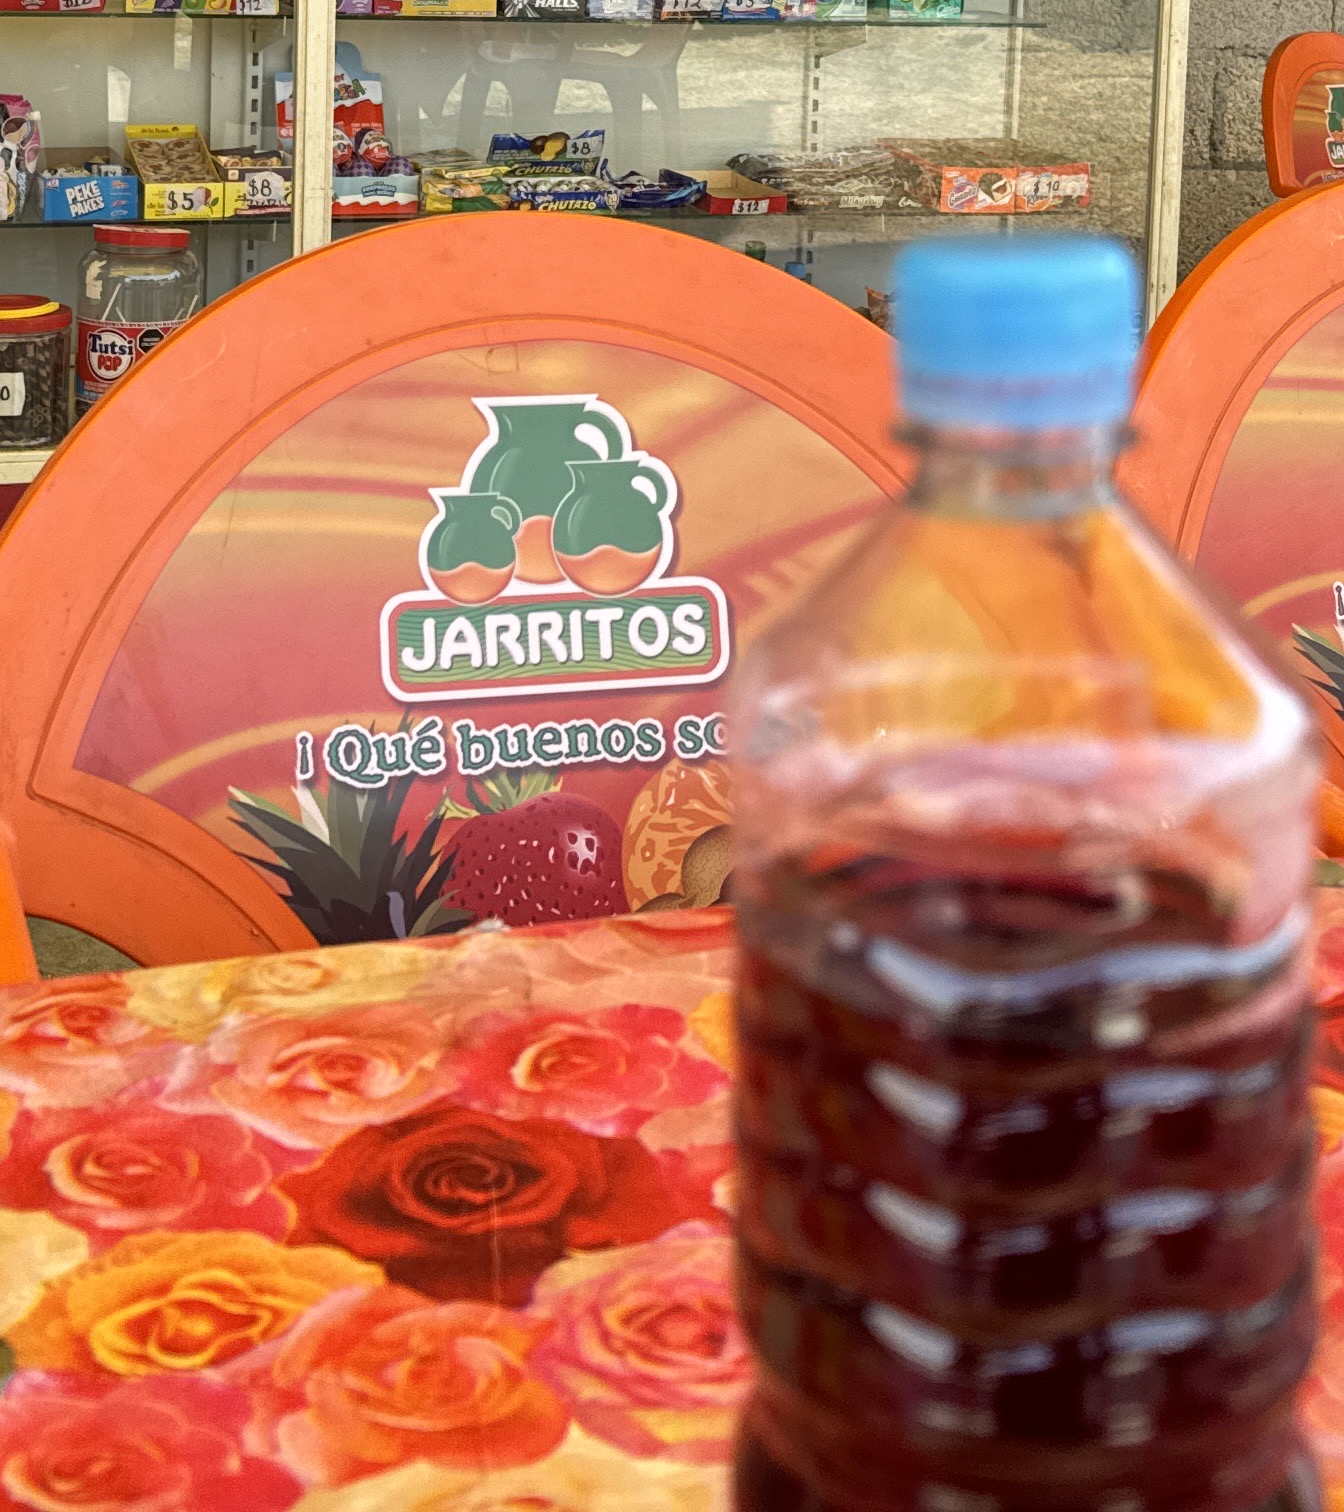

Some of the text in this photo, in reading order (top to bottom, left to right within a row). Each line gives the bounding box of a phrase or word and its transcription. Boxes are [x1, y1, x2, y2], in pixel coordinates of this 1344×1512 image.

[571, 140, 591, 154] $8
[515, 163, 572, 175] CHUTAZO
[65, 181, 99, 204] PEKE
[248, 178, 272, 197] $8
[69, 200, 104, 217] PAKES
[168, 192, 194, 210] $5
[537, 199, 596, 212] CHUTAZO
[89, 332, 134, 356] Tutsi
[97, 355, 121, 370] POP
[400, 603, 707, 672] JARRITOS
[326, 716, 663, 789] Qué buenos
